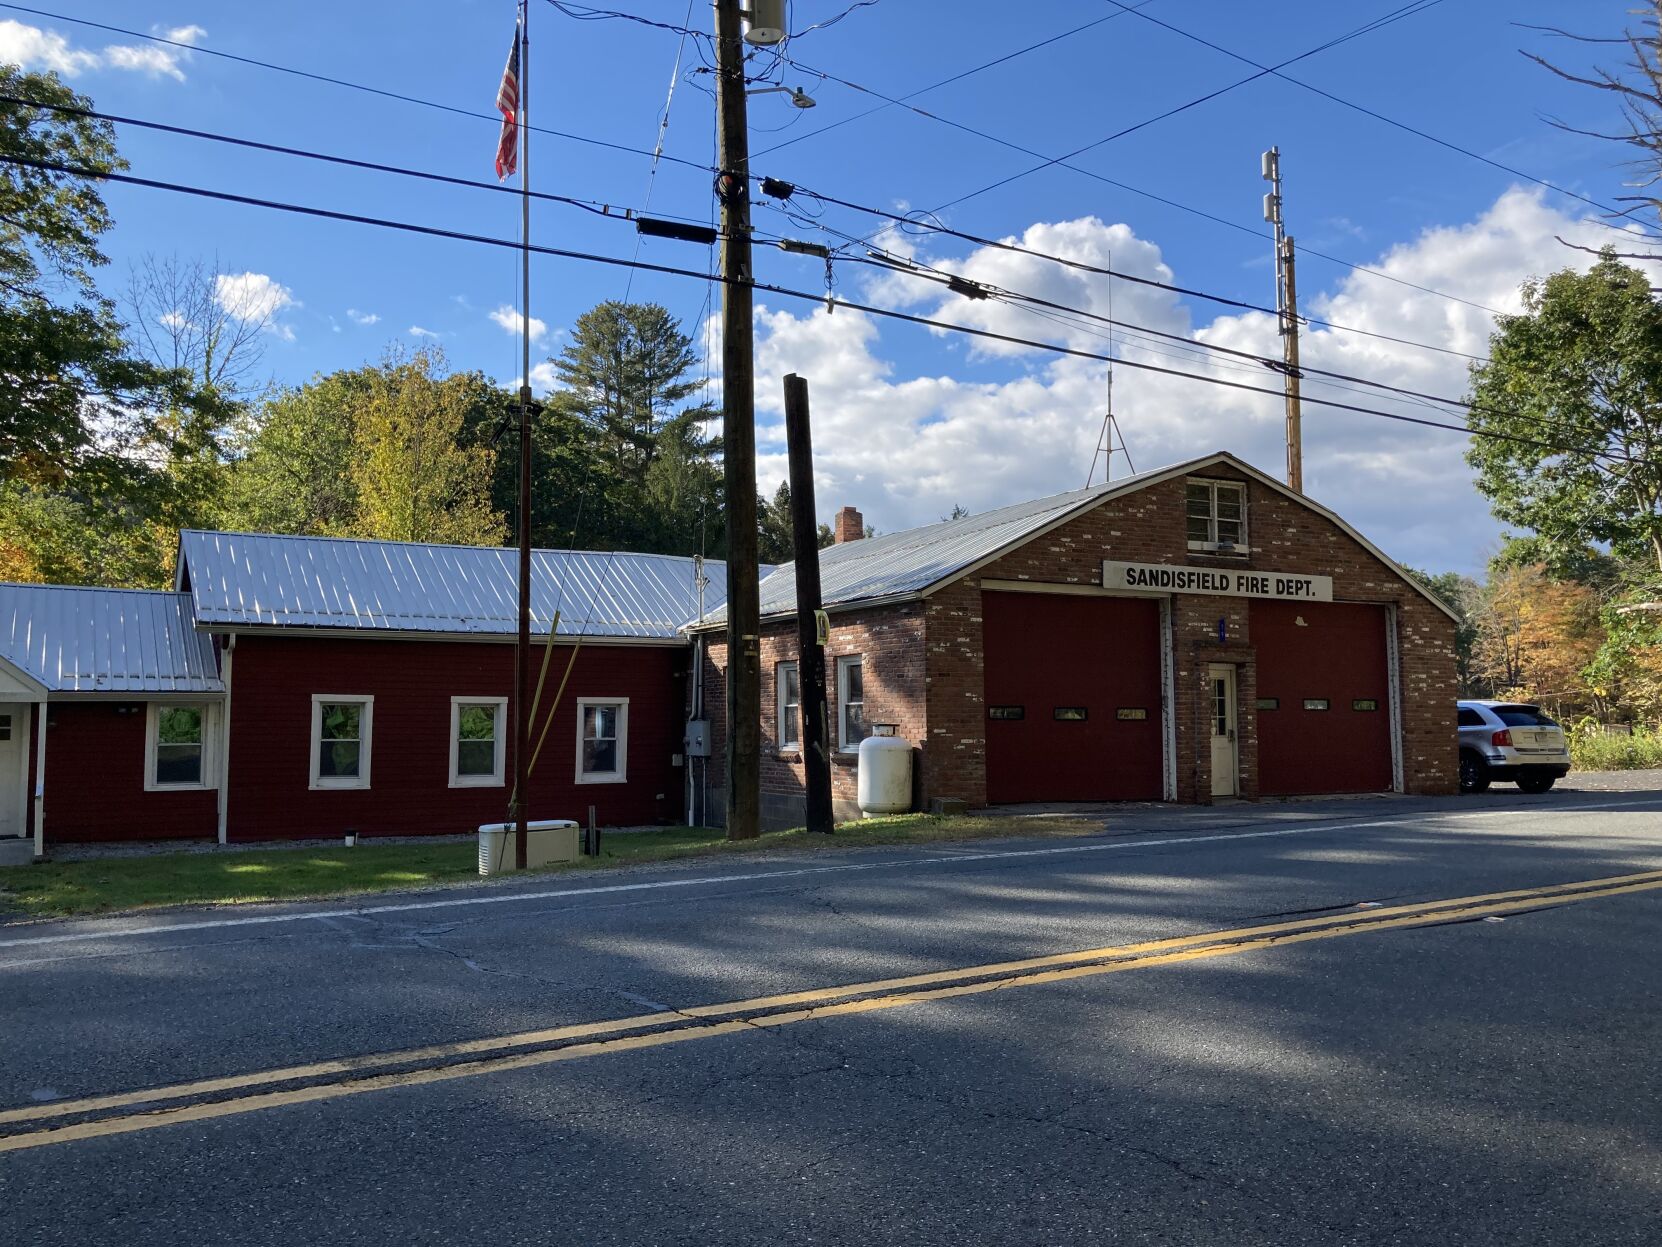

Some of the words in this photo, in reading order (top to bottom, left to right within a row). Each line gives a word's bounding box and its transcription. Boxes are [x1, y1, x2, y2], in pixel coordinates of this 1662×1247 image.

[1126, 567, 1230, 591] SANDISFIELD
[1236, 575, 1269, 594] FIRE
[1276, 579, 1316, 596] DEPT.
